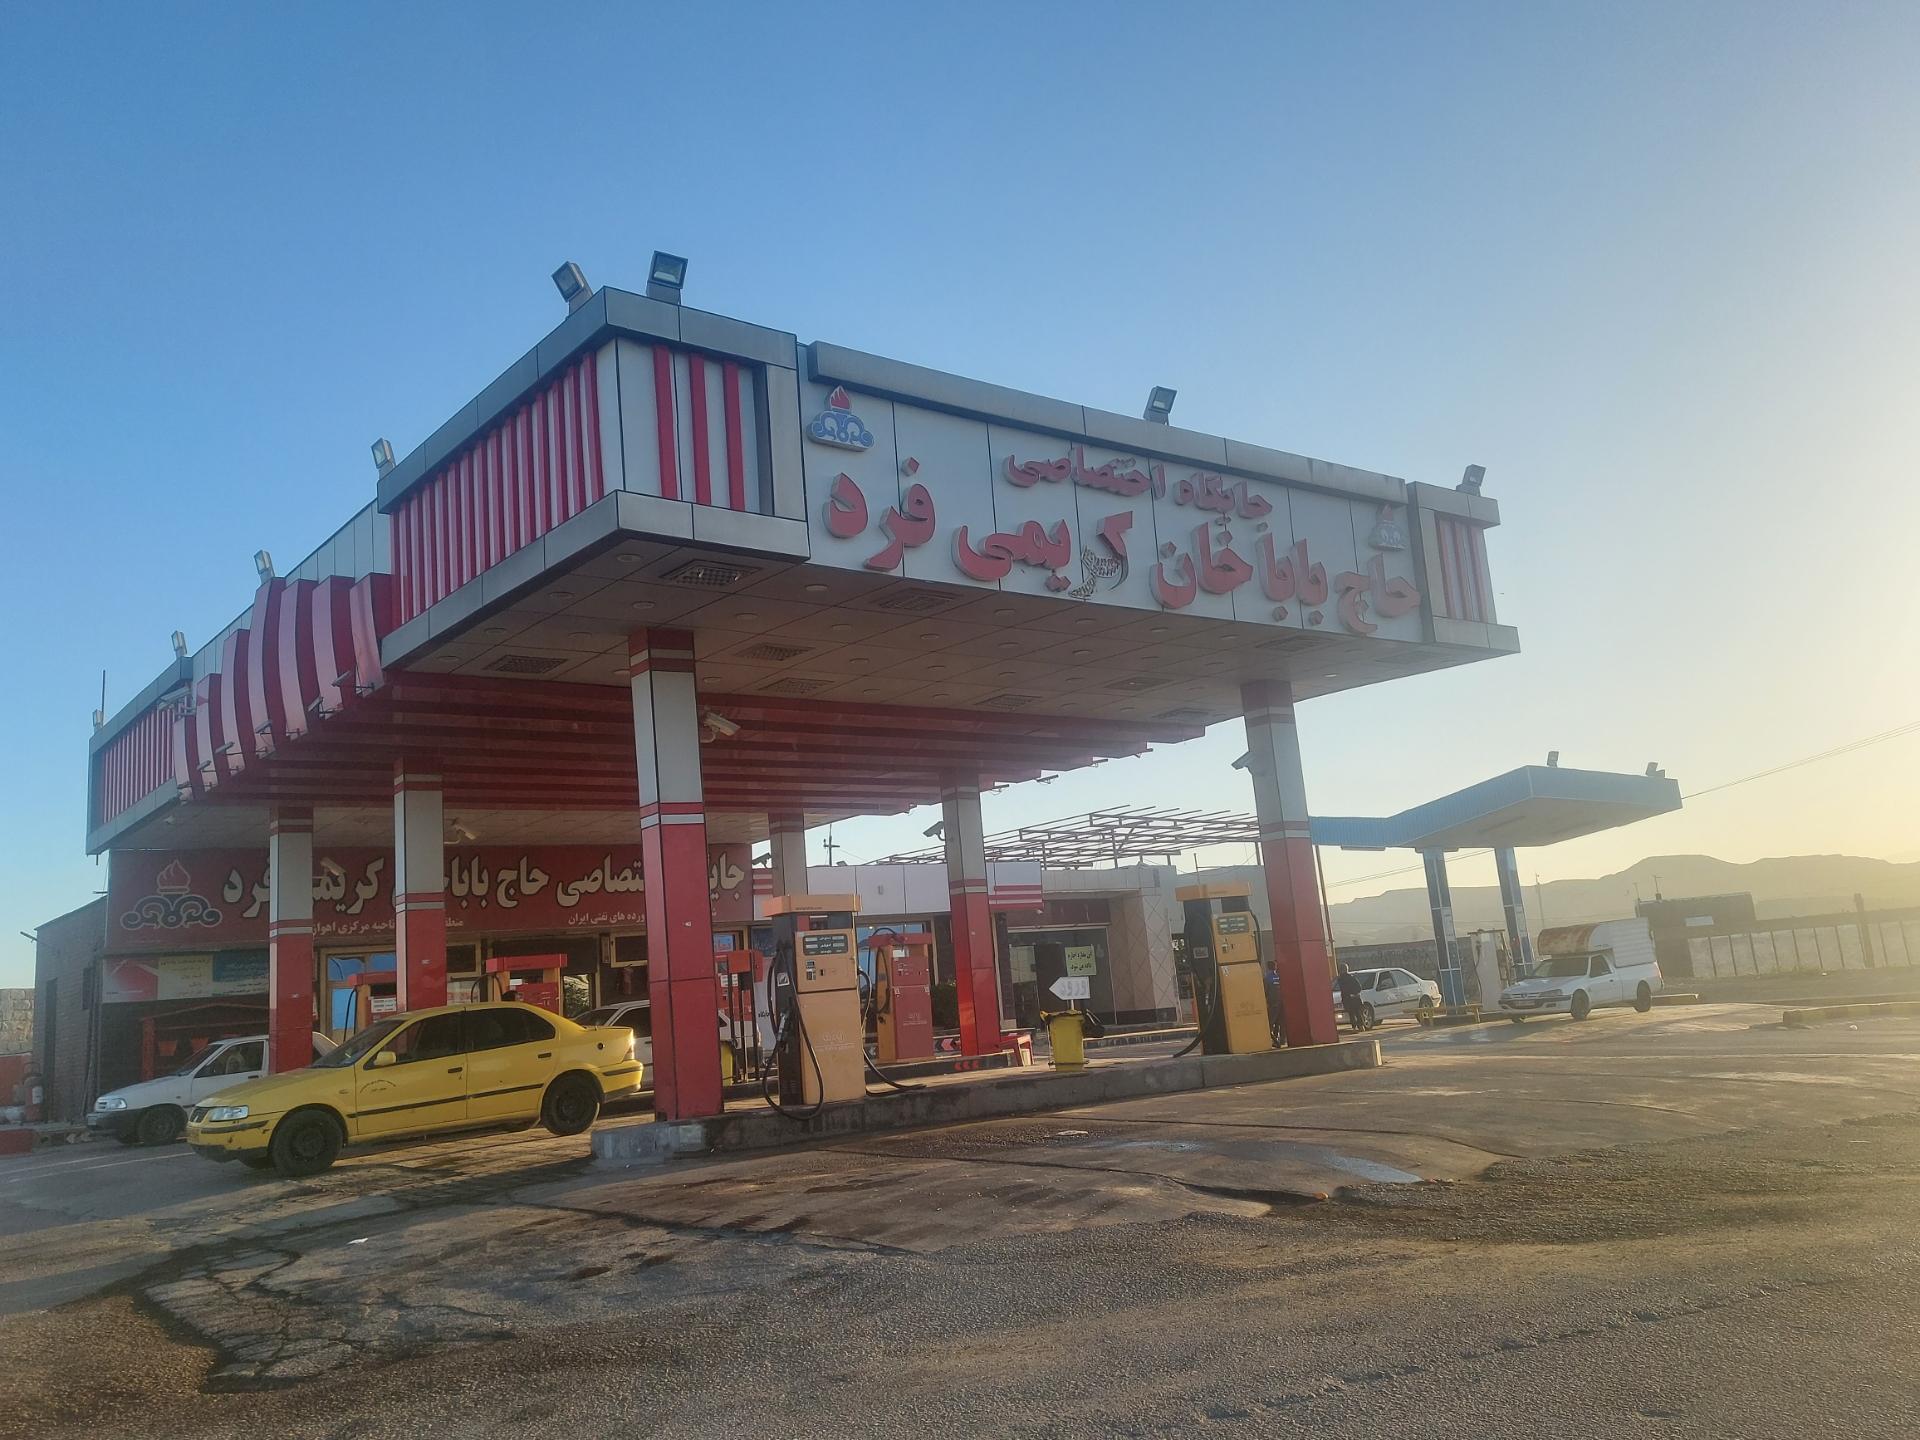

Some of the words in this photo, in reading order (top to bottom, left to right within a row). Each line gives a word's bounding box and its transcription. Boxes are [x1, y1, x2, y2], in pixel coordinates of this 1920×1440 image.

[1003, 447, 1166, 499] اختصاصی
[822, 456, 936, 572] فرد
[1174, 472, 1273, 533] جایگاه
[1150, 521, 1254, 610] خان
[1255, 532, 1329, 626] بابا
[1334, 552, 1421, 637] حاج
[312, 857, 385, 915] کریم
[451, 855, 489, 909] بابا
[496, 855, 549, 908] حاج
[557, 852, 644, 907] تصاصی
[708, 850, 745, 900] جای
[568, 912, 589, 926] ایران
